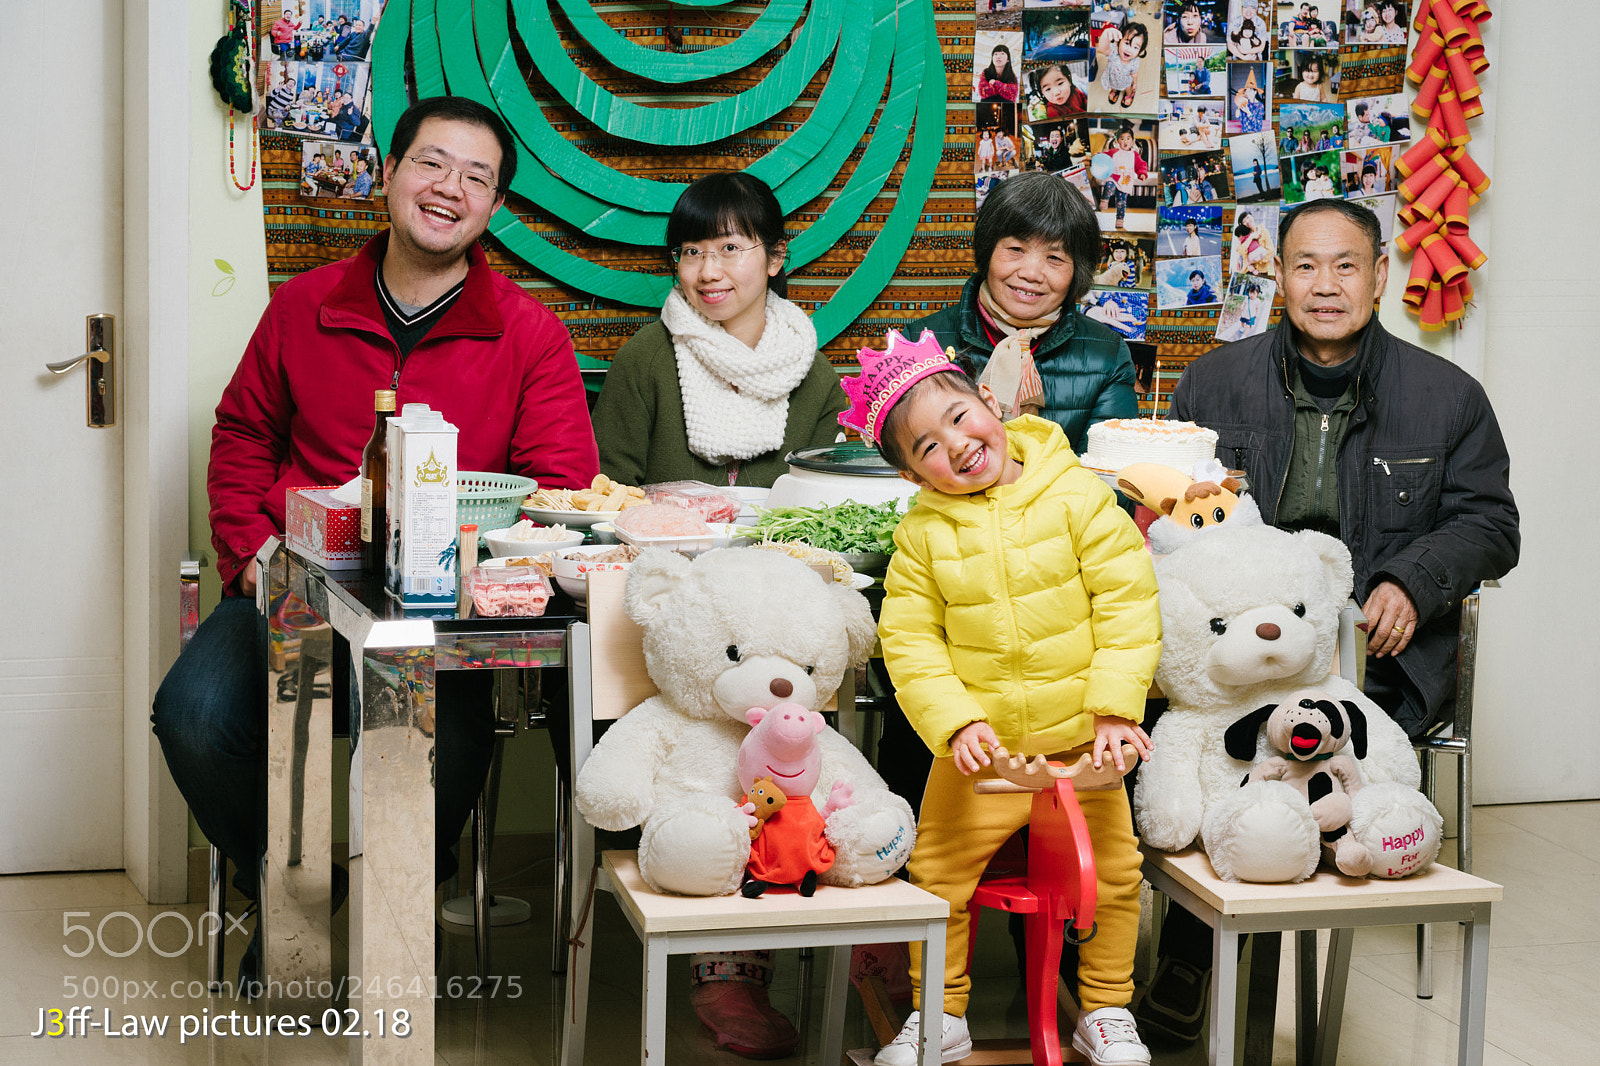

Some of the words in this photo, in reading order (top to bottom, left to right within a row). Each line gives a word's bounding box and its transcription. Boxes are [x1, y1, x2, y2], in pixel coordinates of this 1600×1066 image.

[863, 355, 903, 396] HAPPY
[866, 356, 917, 409] BIRTHDAY
[1382, 824, 1424, 851] Happy
[1401, 851, 1420, 865] For
